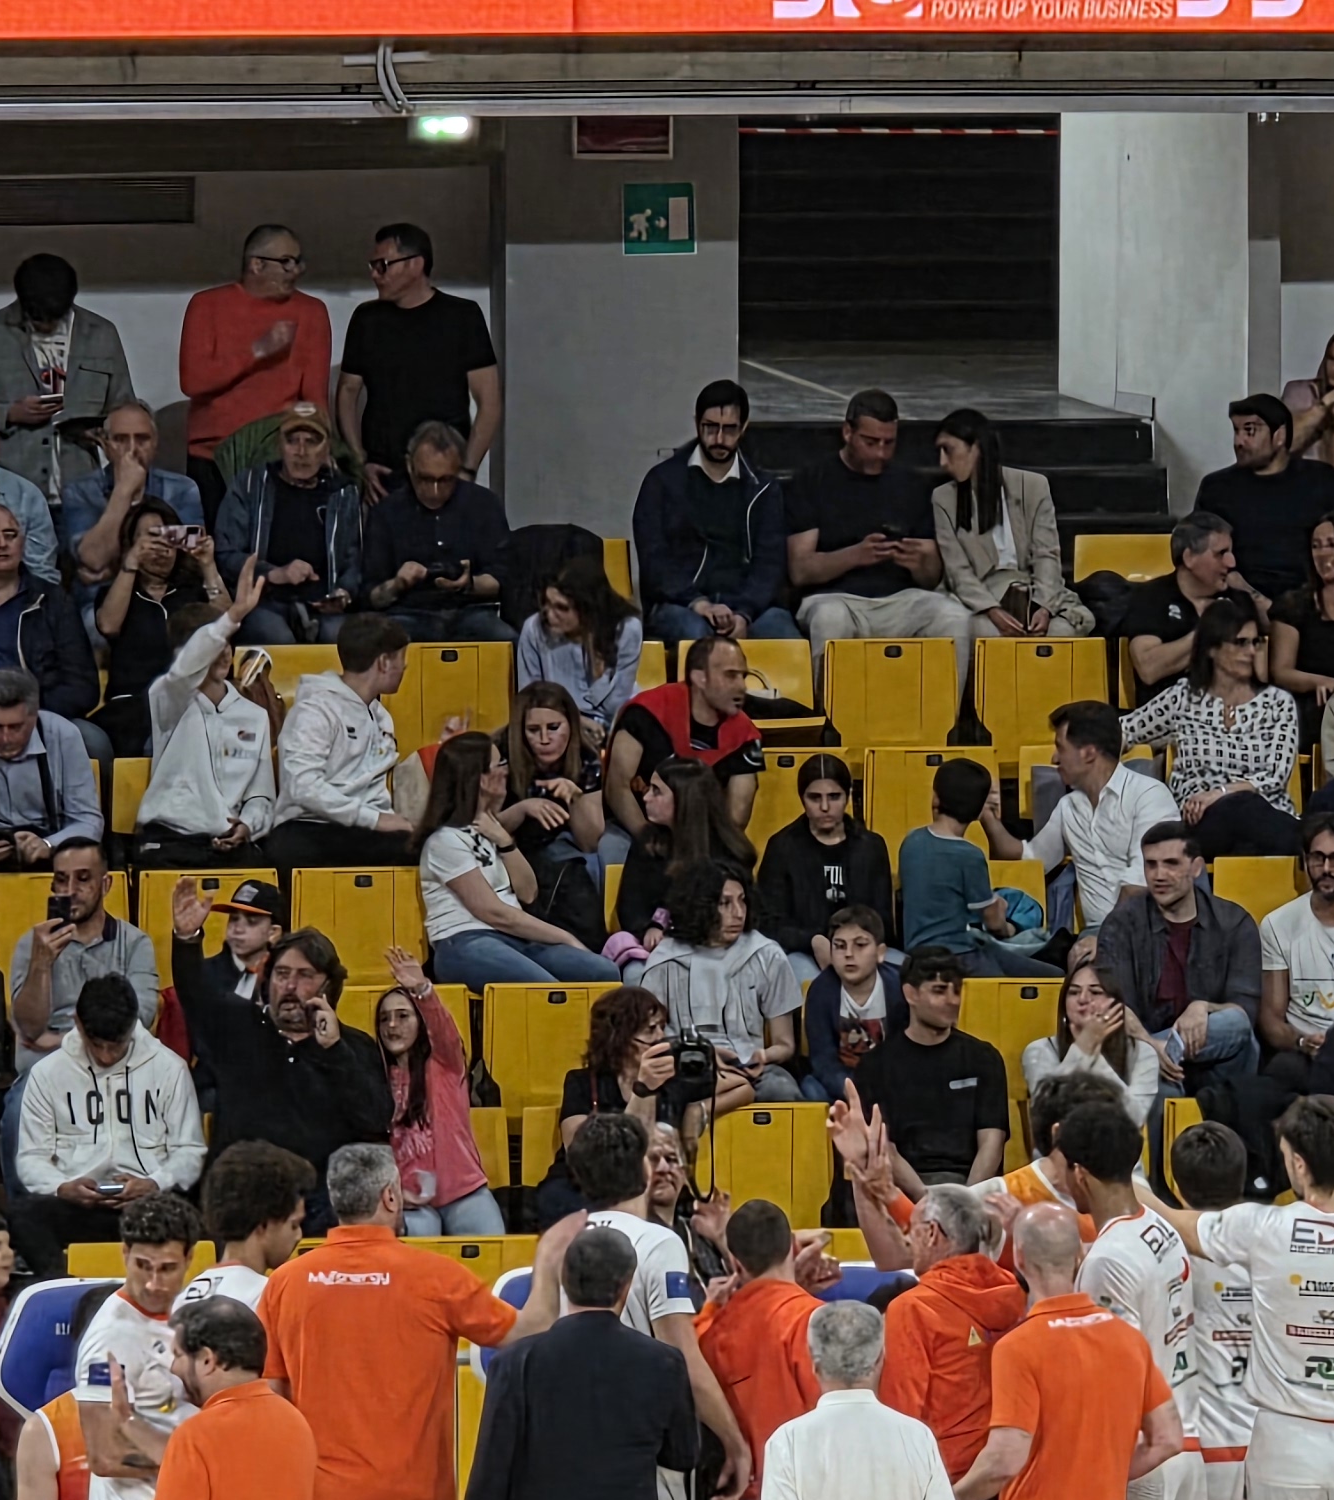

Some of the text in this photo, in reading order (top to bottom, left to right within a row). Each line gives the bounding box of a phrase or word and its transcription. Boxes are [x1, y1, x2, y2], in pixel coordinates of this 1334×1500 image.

[929, 0, 991, 19] POWER
[1000, 0, 1026, 19] UP
[1030, 0, 1079, 19] YOUR
[1081, 0, 1175, 19] BUSINESS
[66, 1088, 161, 1126] ICON
